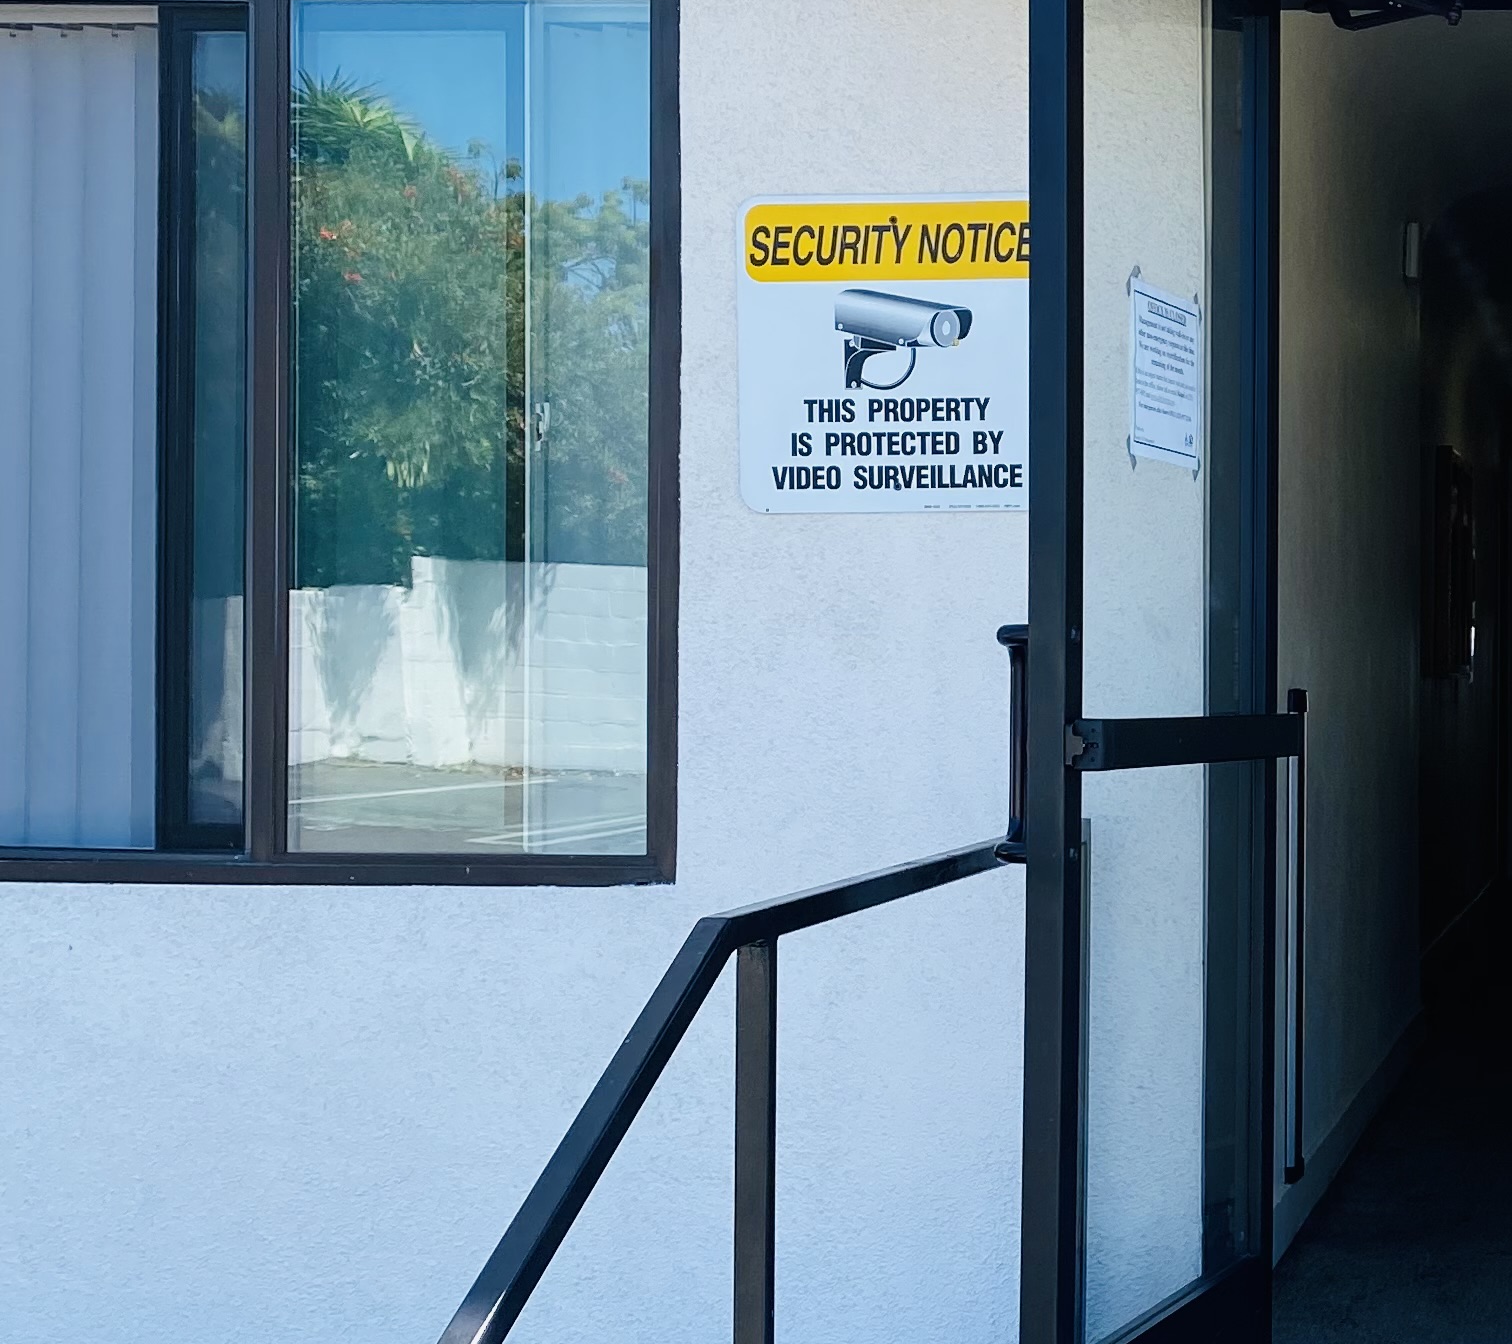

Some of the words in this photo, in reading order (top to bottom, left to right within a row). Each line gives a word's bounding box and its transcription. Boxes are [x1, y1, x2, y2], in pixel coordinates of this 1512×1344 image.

[750, 224, 912, 266] SECURITY
[918, 221, 1029, 264] NOTICE
[803, 398, 855, 423] THIS
[868, 397, 991, 422] PROPERTY
[791, 431, 812, 456] IS
[825, 431, 960, 456] PROTECTED
[973, 430, 1004, 455] BY
[772, 465, 841, 490] VIDEO
[853, 463, 1023, 490] SURVEILLANCE
